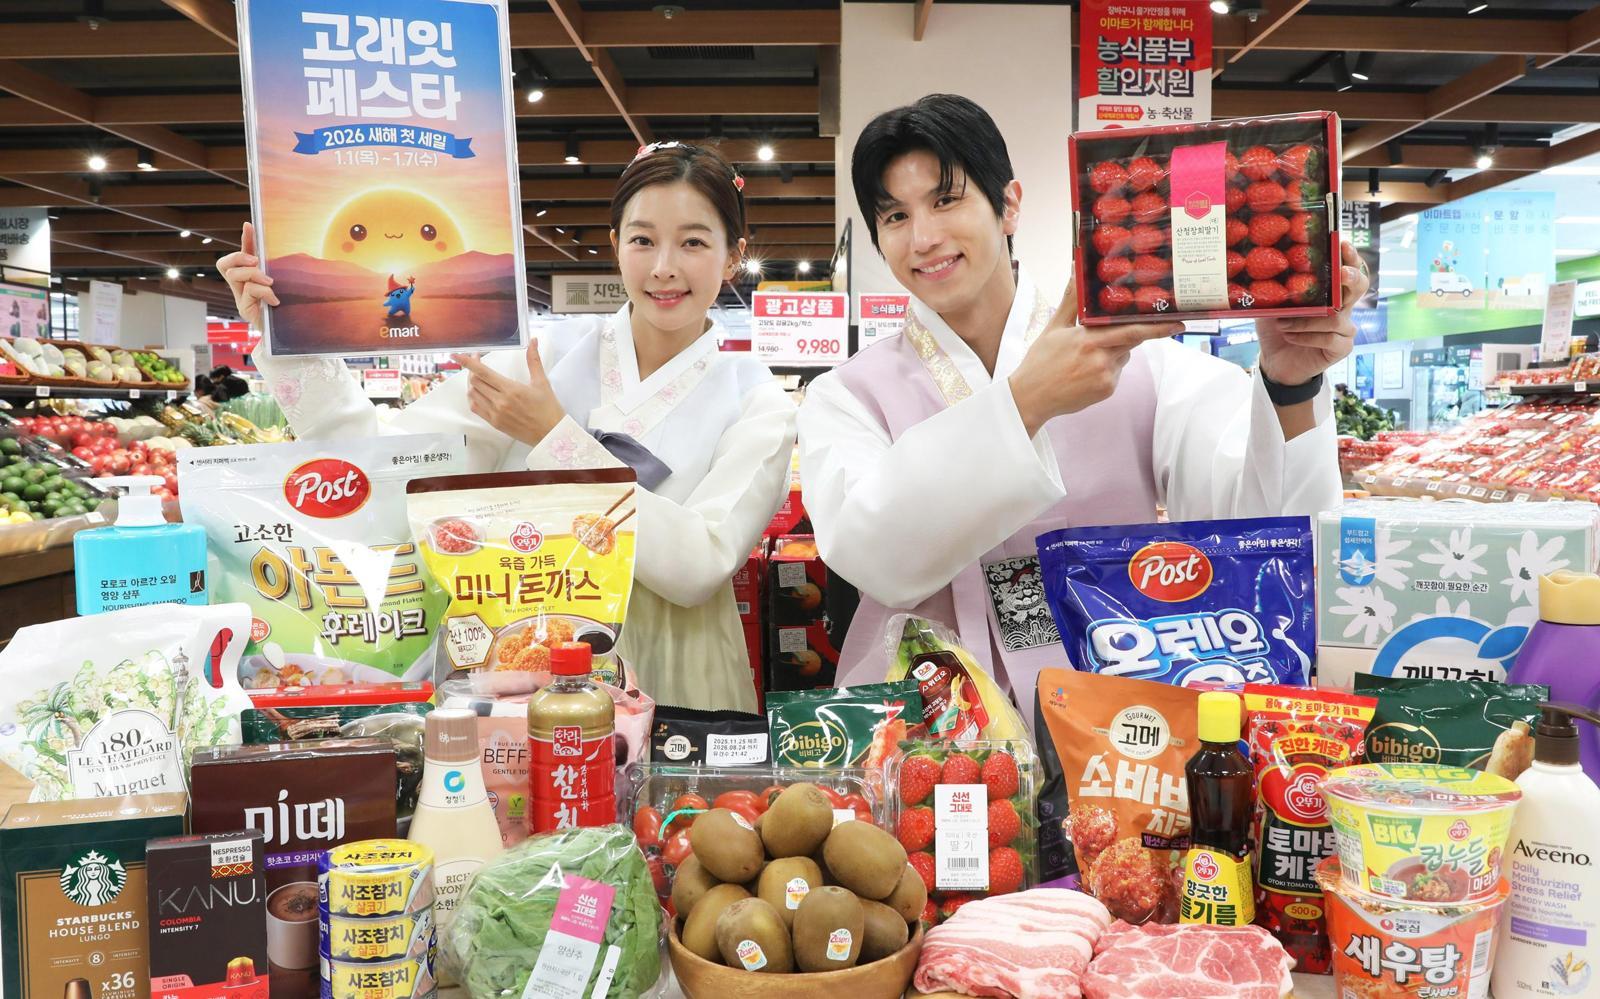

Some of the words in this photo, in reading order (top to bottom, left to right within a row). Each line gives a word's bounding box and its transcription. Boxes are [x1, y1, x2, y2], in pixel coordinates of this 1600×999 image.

[1171, 7, 1186, 17] 위해
[1100, 18, 1141, 30] 이마트가
[1143, 18, 1194, 32] 함께합니다
[301, 12, 457, 68] 고래잇
[1097, 36, 1191, 64] 농식품부
[1097, 67, 1191, 95] 할인지원
[303, 67, 462, 121] 페스타
[323, 128, 365, 147] 2026
[368, 127, 398, 144] 새해
[400, 128, 415, 145] 첫
[418, 130, 447, 151] 세일
[765, 298, 833, 316] 광고상품
[379, 325, 420, 338] emart
[797, 339, 840, 355] 9,980
[392, 455, 422, 465] 좋은아침!
[290, 469, 361, 508] Post
[233, 523, 294, 544] 고소한
[516, 538, 537, 547] 오뚜기
[1238, 537, 1269, 549] 좋은아침!
[499, 556, 525, 571] 육즙
[530, 554, 556, 569] 가득
[250, 543, 425, 610] 아몬드
[1138, 553, 1201, 590] Post
[101, 579, 128, 589] 모로코
[130, 576, 158, 587] 아르간
[160, 574, 177, 584] 오일
[1415, 580, 1446, 591] 깨끗함이
[1447, 582, 1471, 592] 필요한
[1472, 584, 1488, 593] 순간
[100, 590, 119, 601] 영양
[122, 589, 141, 600] 샴푸
[320, 608, 427, 645] 후레이크
[464, 626, 487, 642] 100%
[1091, 611, 1265, 677] 오레오
[922, 670, 947, 693] 스위티오
[1305, 702, 1340, 715] 토마토가
[1125, 711, 1157, 723] GOURMET
[101, 728, 153, 754] 180
[554, 728, 580, 746] 한라
[789, 733, 842, 752] bibigo
[1118, 723, 1161, 747] 고메
[668, 743, 687, 754] 고메
[798, 748, 823, 757] 비비고
[1280, 736, 1311, 753] 진한
[1371, 736, 1436, 764] bibigo
[1392, 767, 1471, 780] BIG
[94, 772, 167, 798] Muguet
[952, 791, 970, 803] 신선
[1295, 796, 1323, 809] 오뚜기
[949, 803, 973, 813] 그대로
[243, 789, 346, 846] 미떼
[1372, 823, 1416, 845] BIG
[212, 845, 251, 856] NESPRESSO
[344, 852, 413, 860] 사조참치
[1420, 837, 1488, 877] 컵누들
[1512, 838, 1591, 867] Aveeno
[217, 854, 246, 864] 호환캡슐
[266, 855, 292, 867] 핫초코
[1512, 861, 1540, 877] Daily
[1287, 881, 1314, 889] TOMATO
[1511, 871, 1580, 892] Moisturizing
[341, 881, 403, 901] 사조참치
[1186, 879, 1228, 902] 향긋한
[1511, 880, 1545, 897] Stress
[1547, 888, 1582, 902] Relief
[356, 900, 387, 913] 살코기
[577, 893, 599, 908] 신선
[1521, 895, 1543, 906] BODY
[1543, 900, 1567, 910] WASH
[56, 910, 133, 927] STARBUCKS
[571, 903, 597, 919] 그대로
[49, 925, 95, 939] HOUSE
[98, 920, 140, 933] BLEND
[159, 916, 203, 927] COLOMBIA
[1396, 922, 1421, 934] 농심
[79, 933, 111, 943] LUNGO
[160, 926, 194, 935] INTENSITY
[343, 924, 405, 945] 사조참치
[358, 944, 390, 956] 살코기
[92, 953, 101, 964] 8
[1344, 933, 1463, 985] 새우탕
[101, 971, 136, 992] x36
[161, 976, 186, 984] SINGLE
[161, 982, 186, 990] ORIGIN
[349, 967, 410, 989] 사조참치
[364, 987, 394, 999] 살코기
[1417, 985, 1459, 999] 큰사발면
